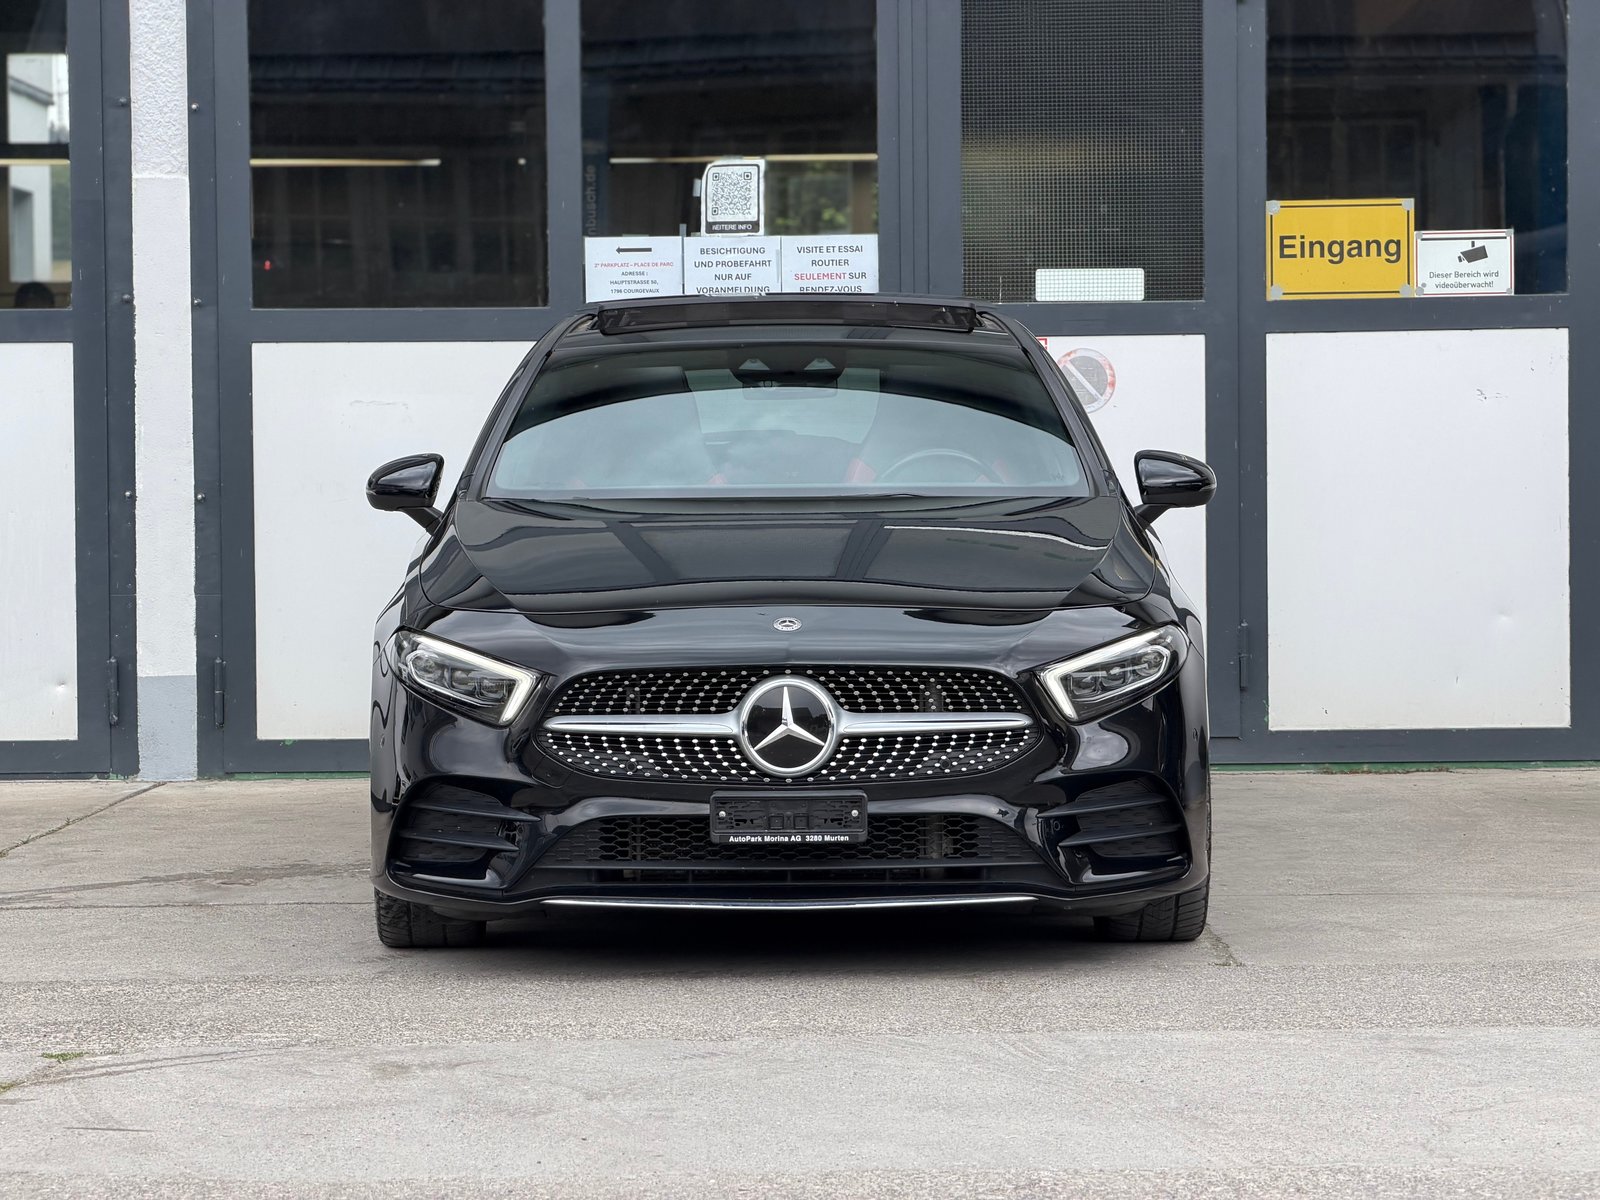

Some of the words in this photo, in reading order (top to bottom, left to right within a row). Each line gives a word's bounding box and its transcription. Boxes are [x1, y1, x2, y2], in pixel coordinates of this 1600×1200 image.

[700, 247, 766, 255] BESICHTIGUNG
[796, 246, 824, 254] VISITE
[838, 245, 863, 253] ESSAI
[1279, 235, 1401, 264] Eingang
[694, 260, 714, 268] UND
[715, 260, 772, 268] PROBEFAHRT
[811, 259, 850, 267] ROUTIER
[714, 273, 734, 281] NUR
[735, 273, 752, 281] AUF
[794, 272, 847, 281] SEULEMENT
[848, 271, 867, 280] SUR
[1429, 271, 1453, 279] Dieser
[1454, 270, 1482, 279] Bereich
[1483, 270, 1499, 278] wird
[1435, 280, 1494, 289] videoüberwacht!
